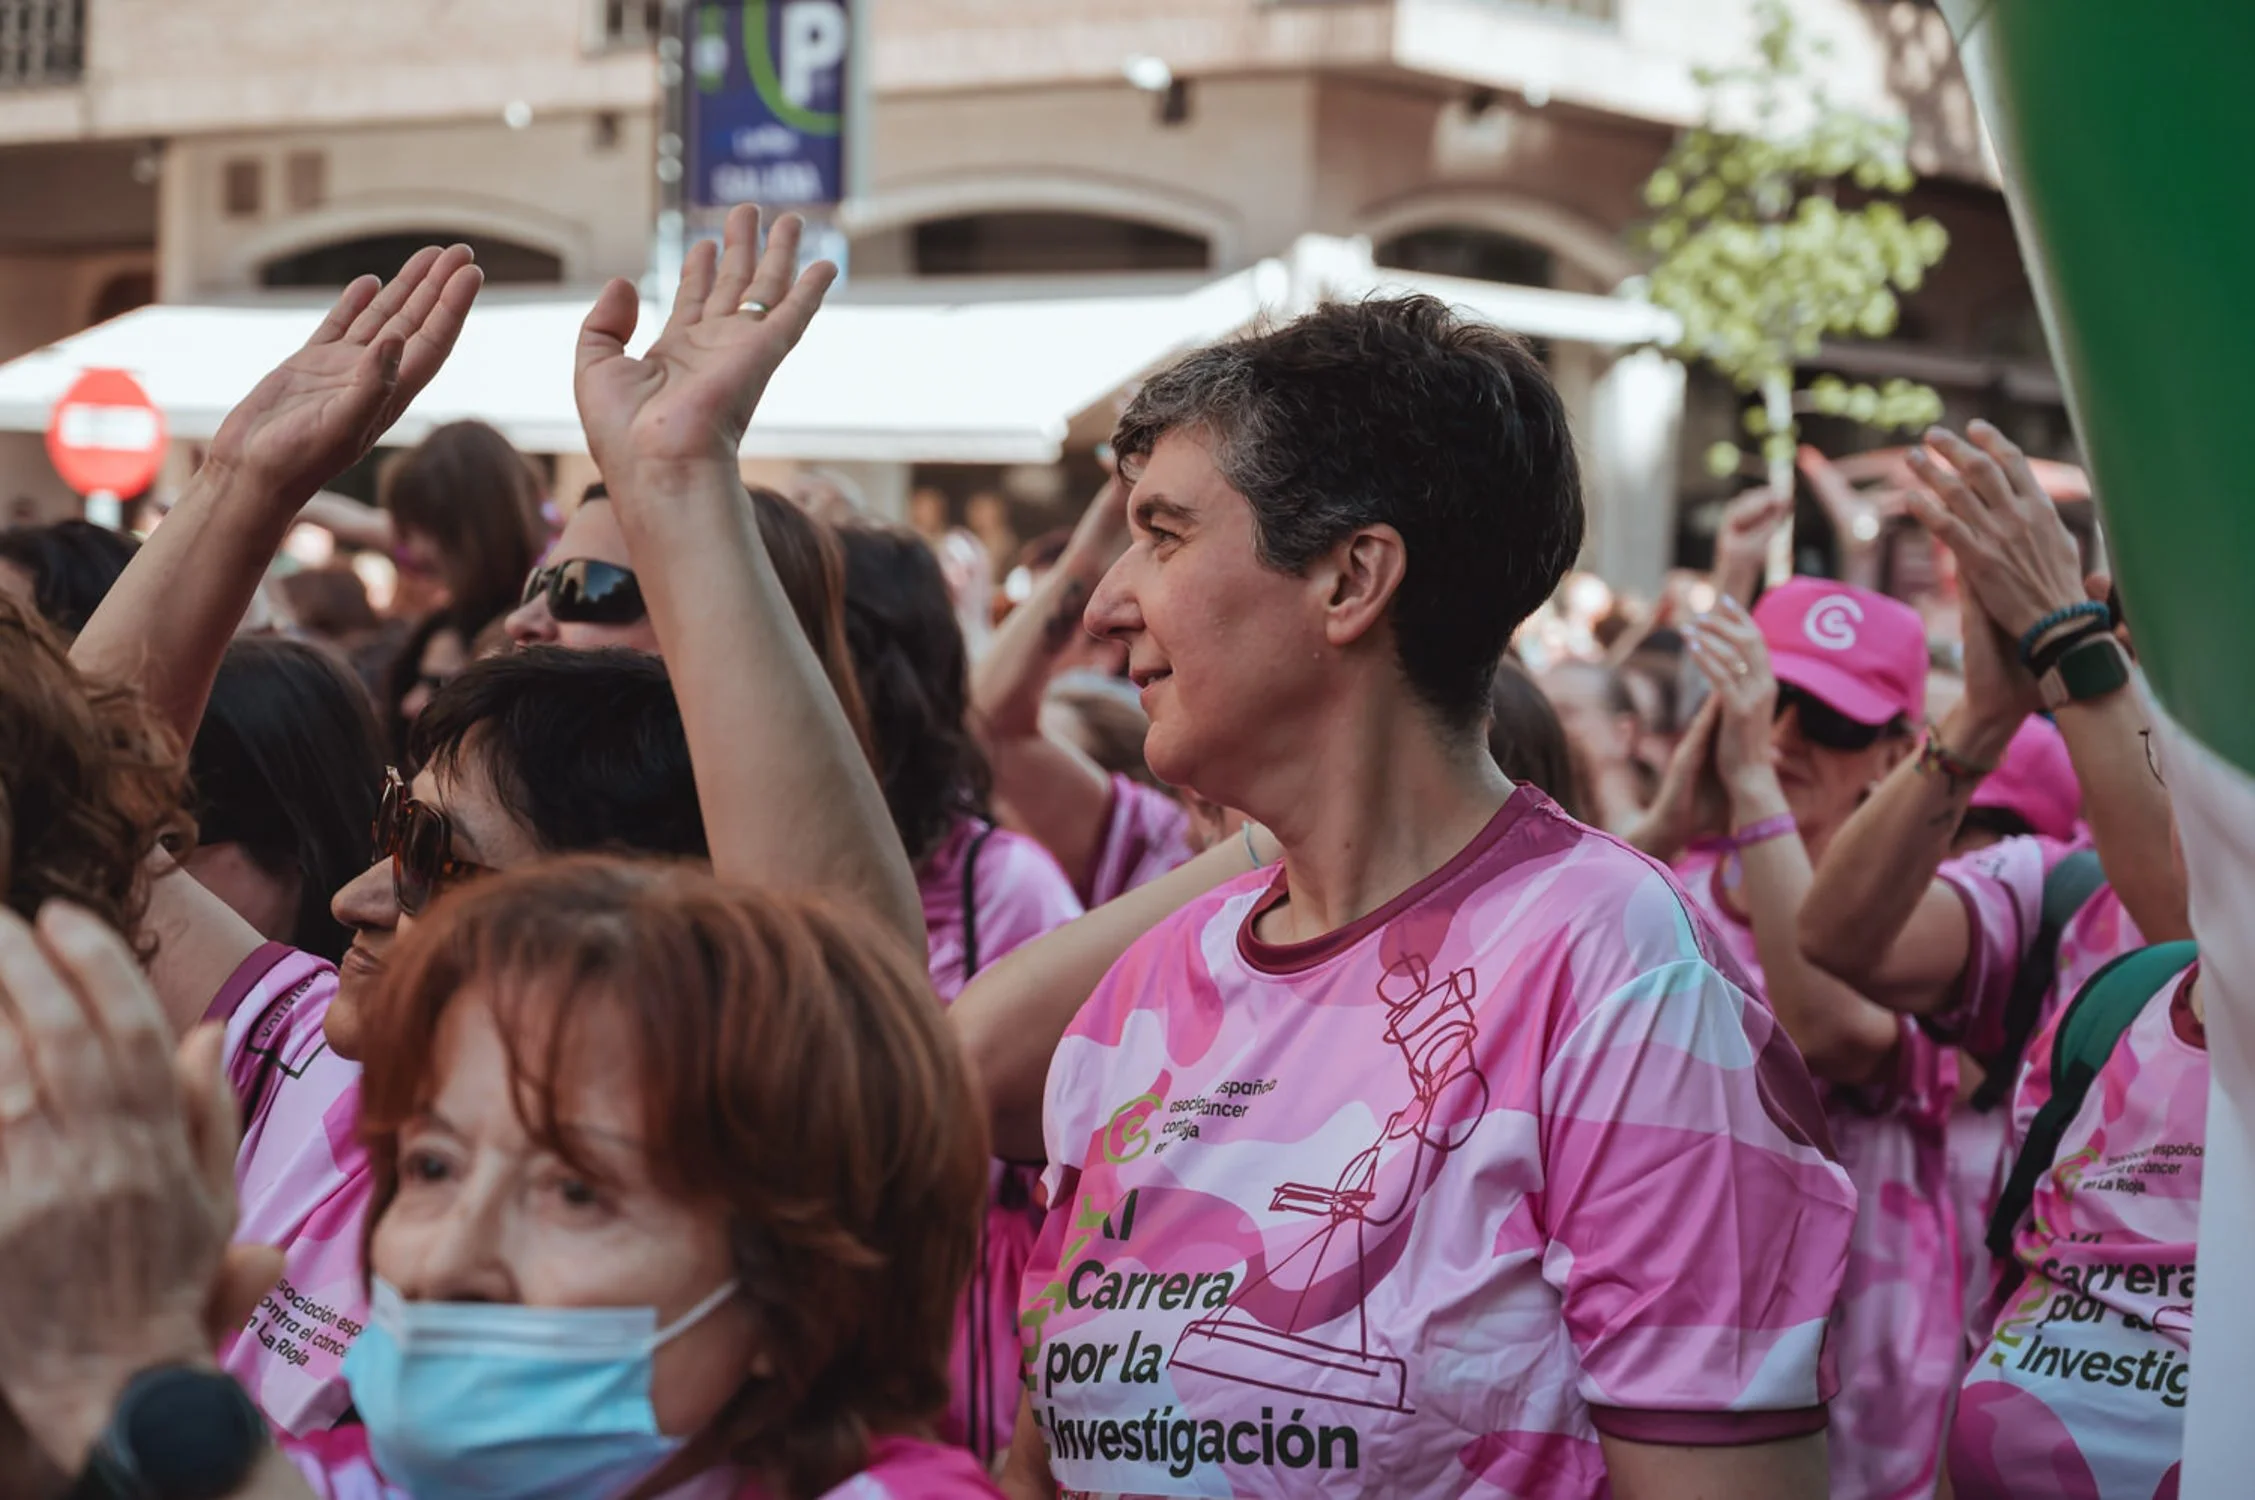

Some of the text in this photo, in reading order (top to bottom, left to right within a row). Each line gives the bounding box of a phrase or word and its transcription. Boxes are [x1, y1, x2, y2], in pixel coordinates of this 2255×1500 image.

[276, 1278, 338, 1327] sociación
[1067, 1259, 1234, 1310] Carrera
[260, 1296, 301, 1334] ontra
[299, 1327, 318, 1342] el
[257, 1322, 276, 1350] La
[275, 1338, 310, 1367] Rioja
[1046, 1330, 1162, 1398] por la
[1048, 1406, 1359, 1478] Investigación
